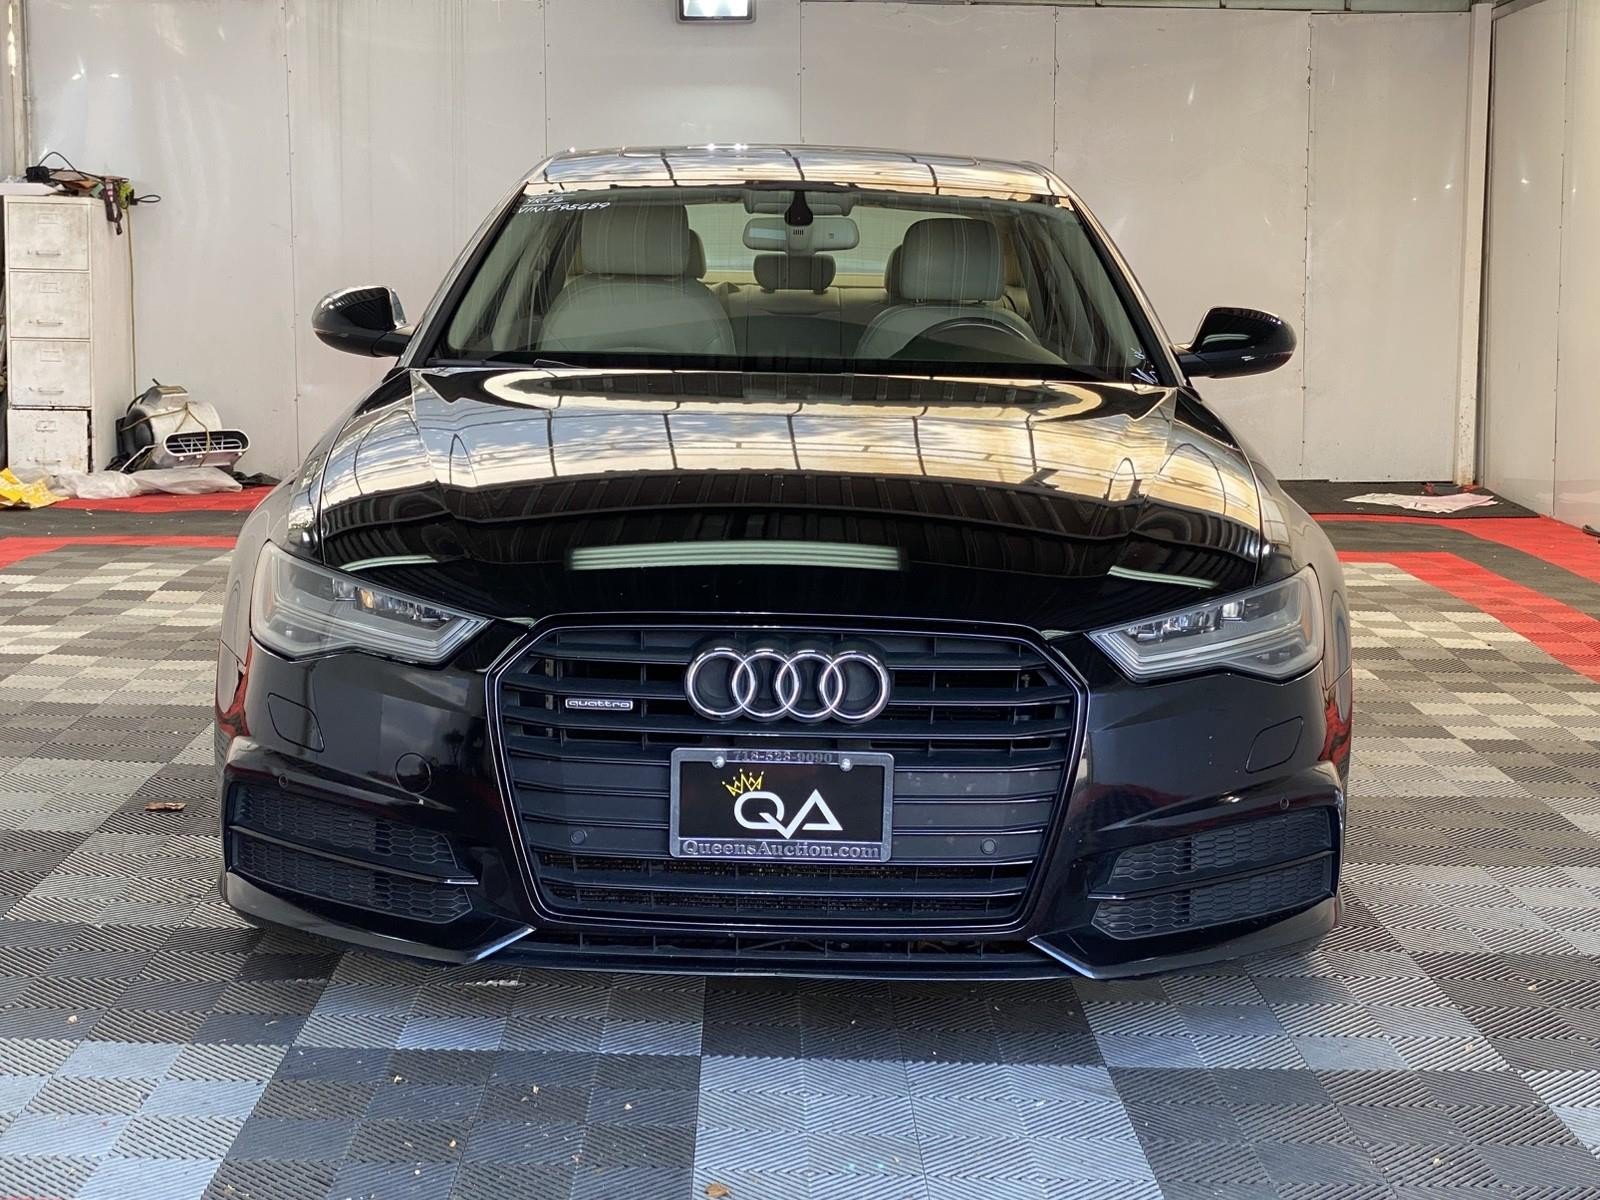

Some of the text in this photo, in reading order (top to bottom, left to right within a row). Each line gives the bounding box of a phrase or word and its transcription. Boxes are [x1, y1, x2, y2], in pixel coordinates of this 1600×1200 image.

[568, 700, 630, 708] quattro
[734, 789, 843, 839] QA
[682, 839, 880, 858] QueensAuction.com
